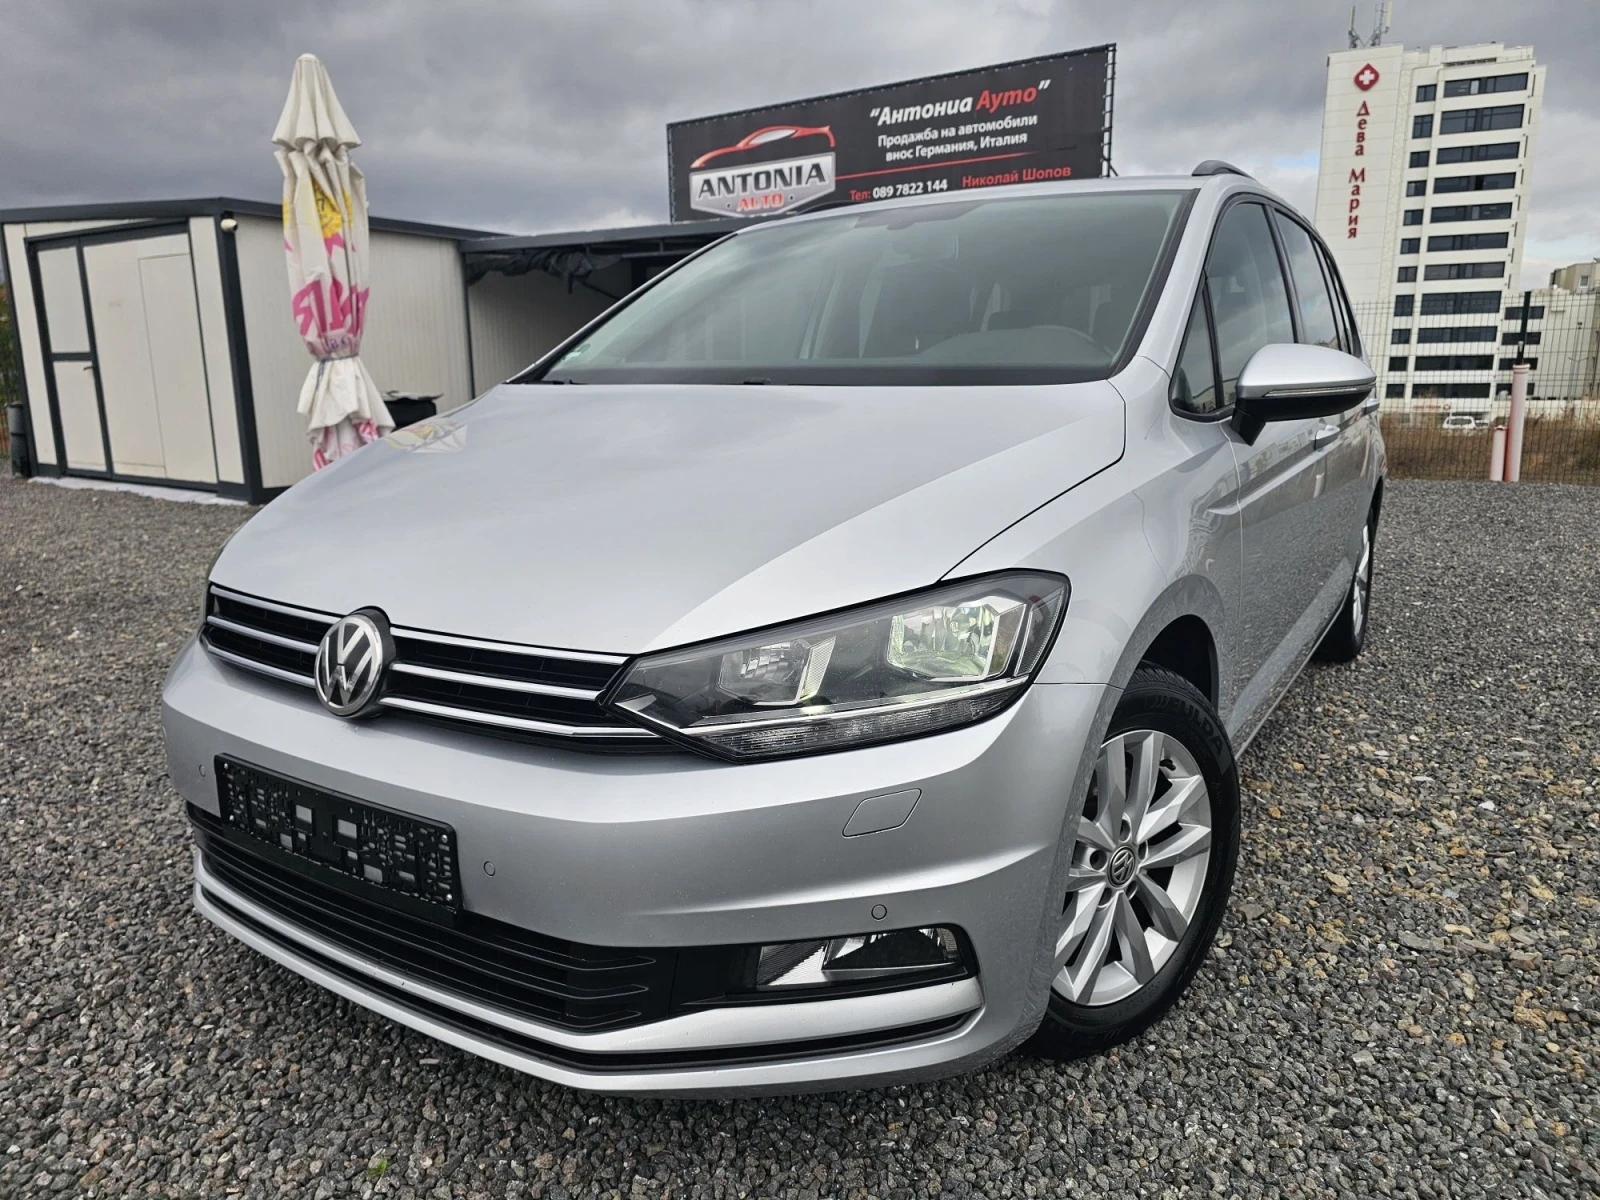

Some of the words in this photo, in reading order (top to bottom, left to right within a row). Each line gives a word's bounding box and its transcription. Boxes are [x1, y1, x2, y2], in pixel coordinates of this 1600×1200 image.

[878, 127, 938, 149] Продажба
[941, 128, 956, 138] на
[958, 114, 1038, 135] автомобили
[1355, 101, 1370, 156] Дева
[886, 148, 913, 162] внос
[915, 140, 978, 159] Германия,
[980, 133, 1028, 149] Италия
[699, 163, 826, 198] ANTONIA
[850, 189, 871, 201] Тел:
[873, 185, 894, 199] 089
[896, 182, 923, 197] 7822
[926, 179, 948, 192] 144
[962, 169, 1018, 187] Николай
[1023, 167, 1071, 181] Шопов
[737, 192, 784, 210] AUTO
[1348, 167, 1365, 239] Мария
